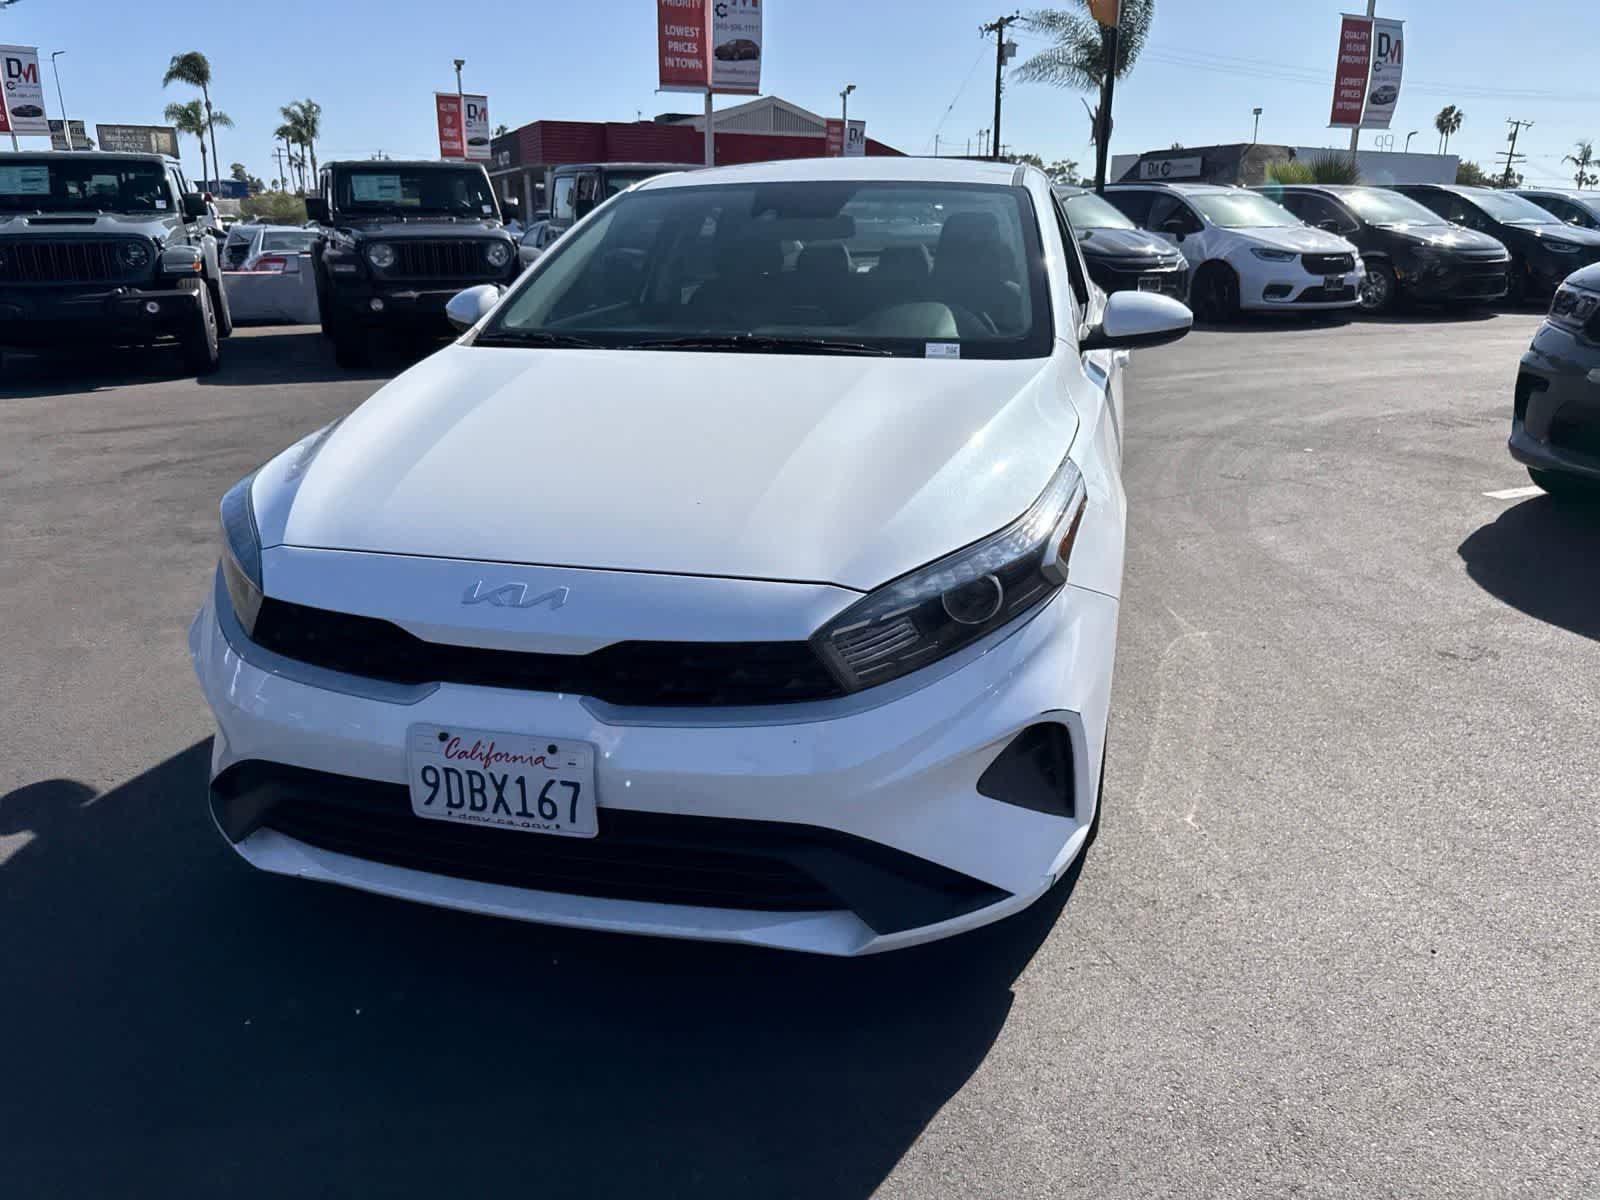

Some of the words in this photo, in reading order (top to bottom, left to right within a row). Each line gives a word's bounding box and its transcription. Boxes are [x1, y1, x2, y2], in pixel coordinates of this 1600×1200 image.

[665, 25, 700, 38] LOWEST
[1344, 30, 1368, 40] QUALITY
[668, 40, 698, 53] PRICES
[665, 57, 673, 67] IN
[675, 57, 703, 70] TOWN
[445, 736, 559, 770] California
[421, 765, 581, 824] 9DBX167
[458, 813, 551, 831] dmv.ca.gov
